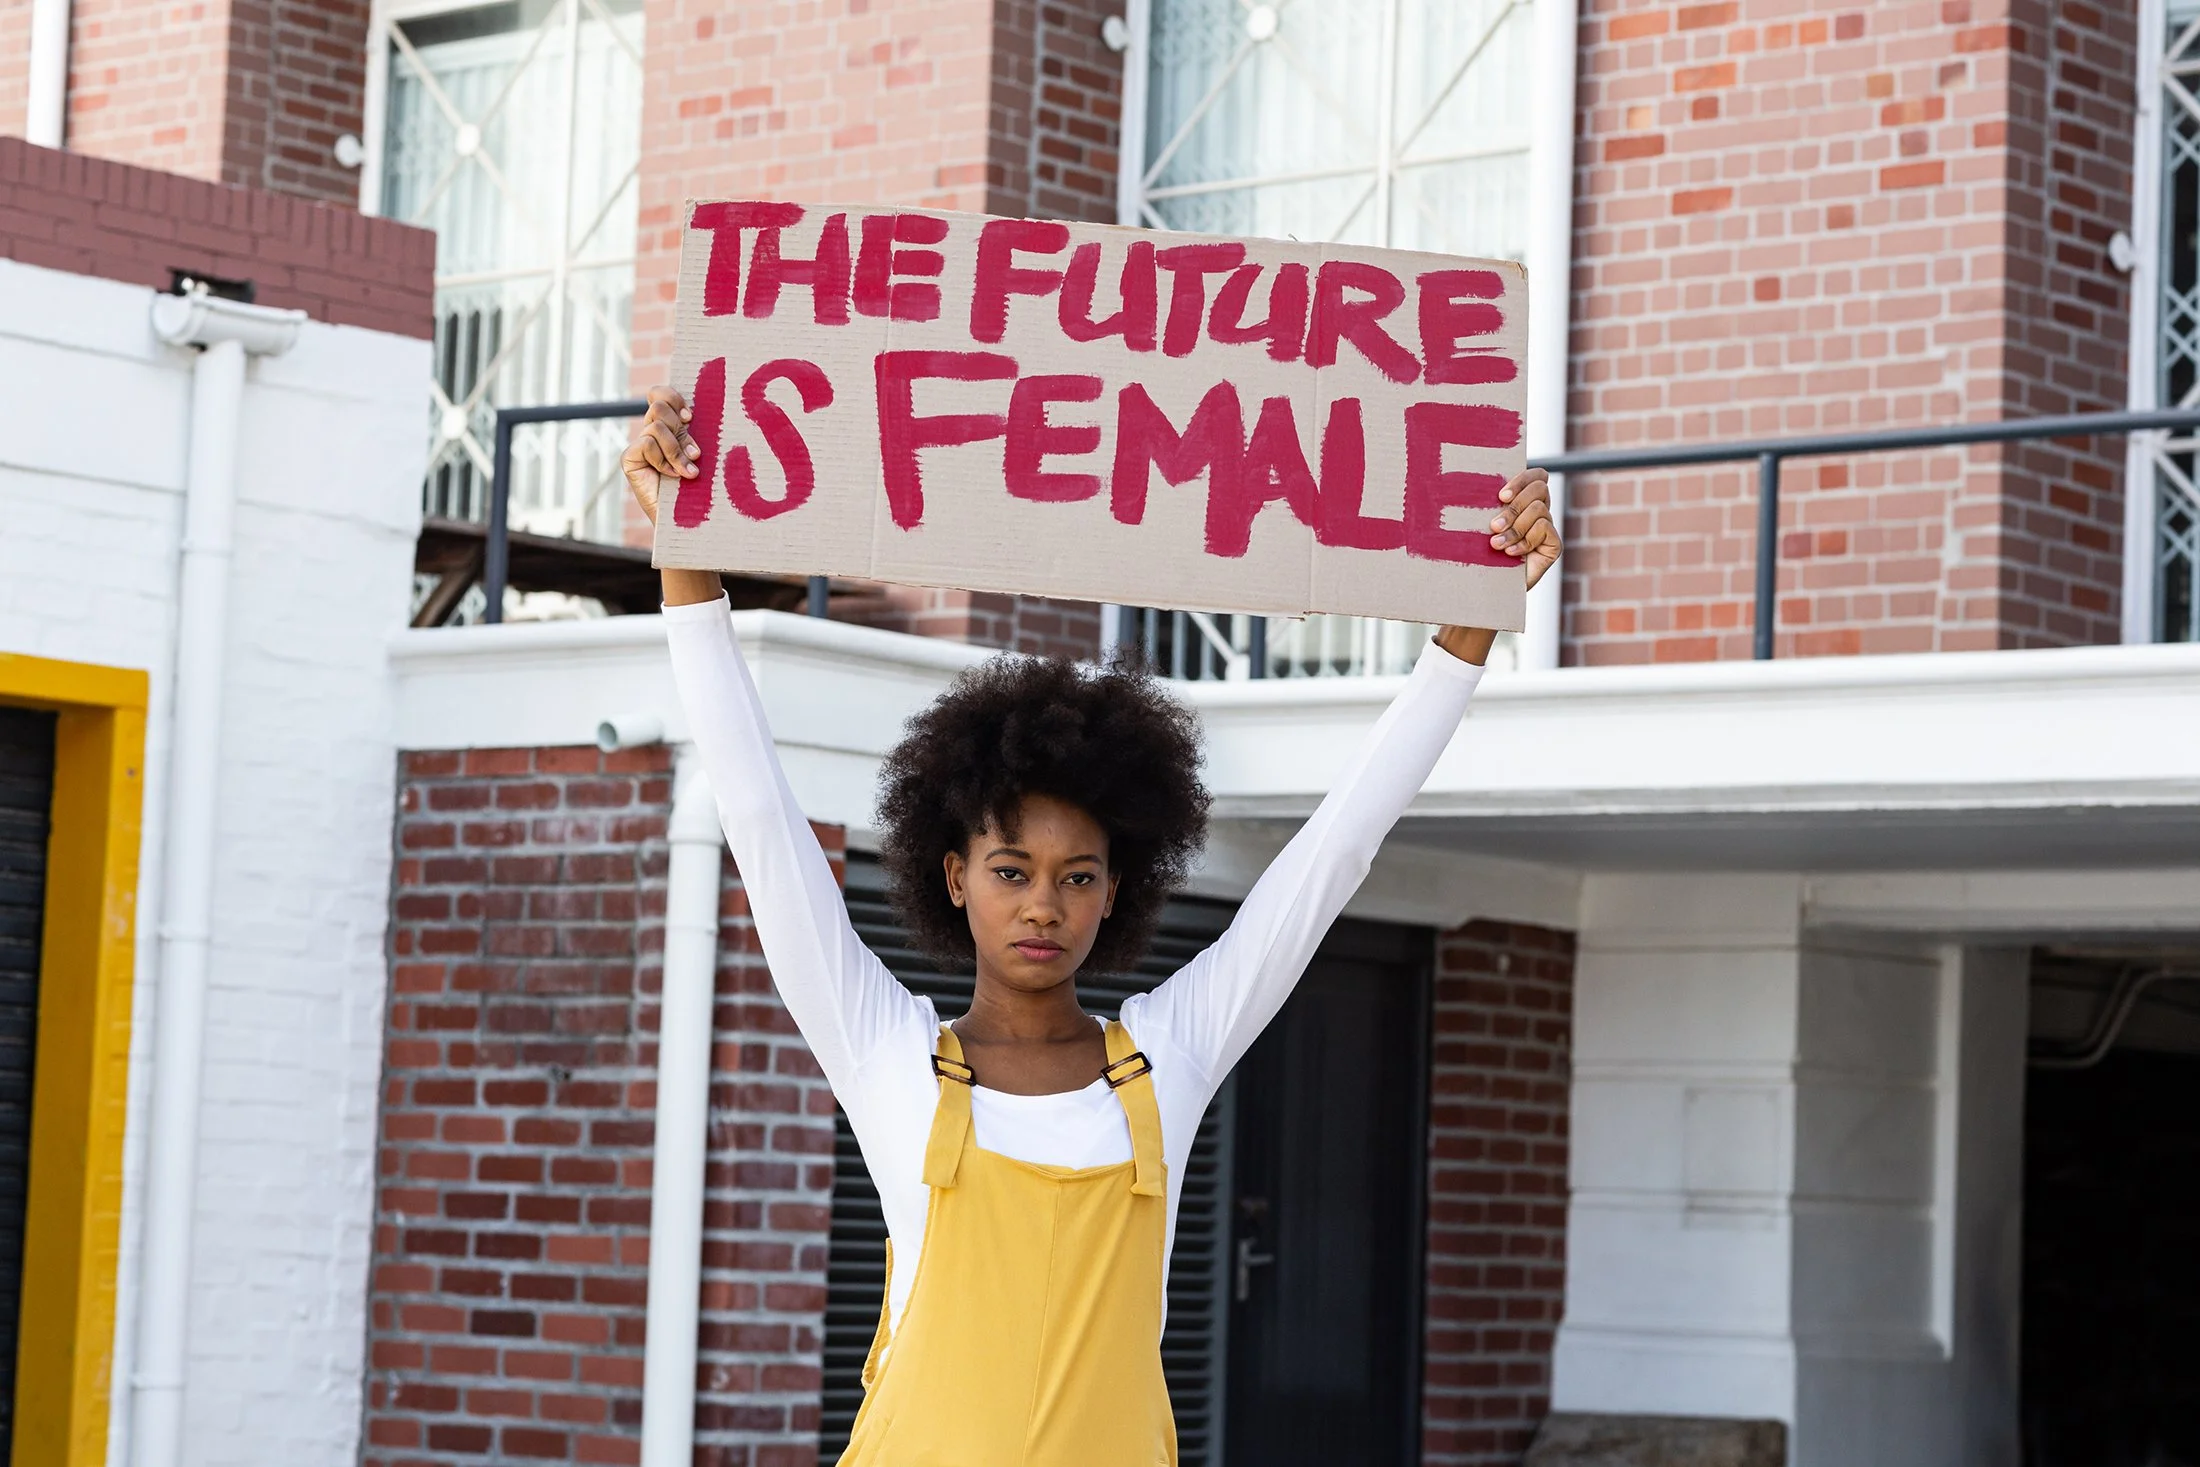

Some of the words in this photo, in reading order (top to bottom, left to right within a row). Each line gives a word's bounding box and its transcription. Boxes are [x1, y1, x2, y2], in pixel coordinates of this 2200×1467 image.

[691, 202, 947, 323] THE
[971, 220, 1517, 383] FUTURE
[674, 358, 833, 526] IS
[875, 351, 1524, 567] FEMALE
